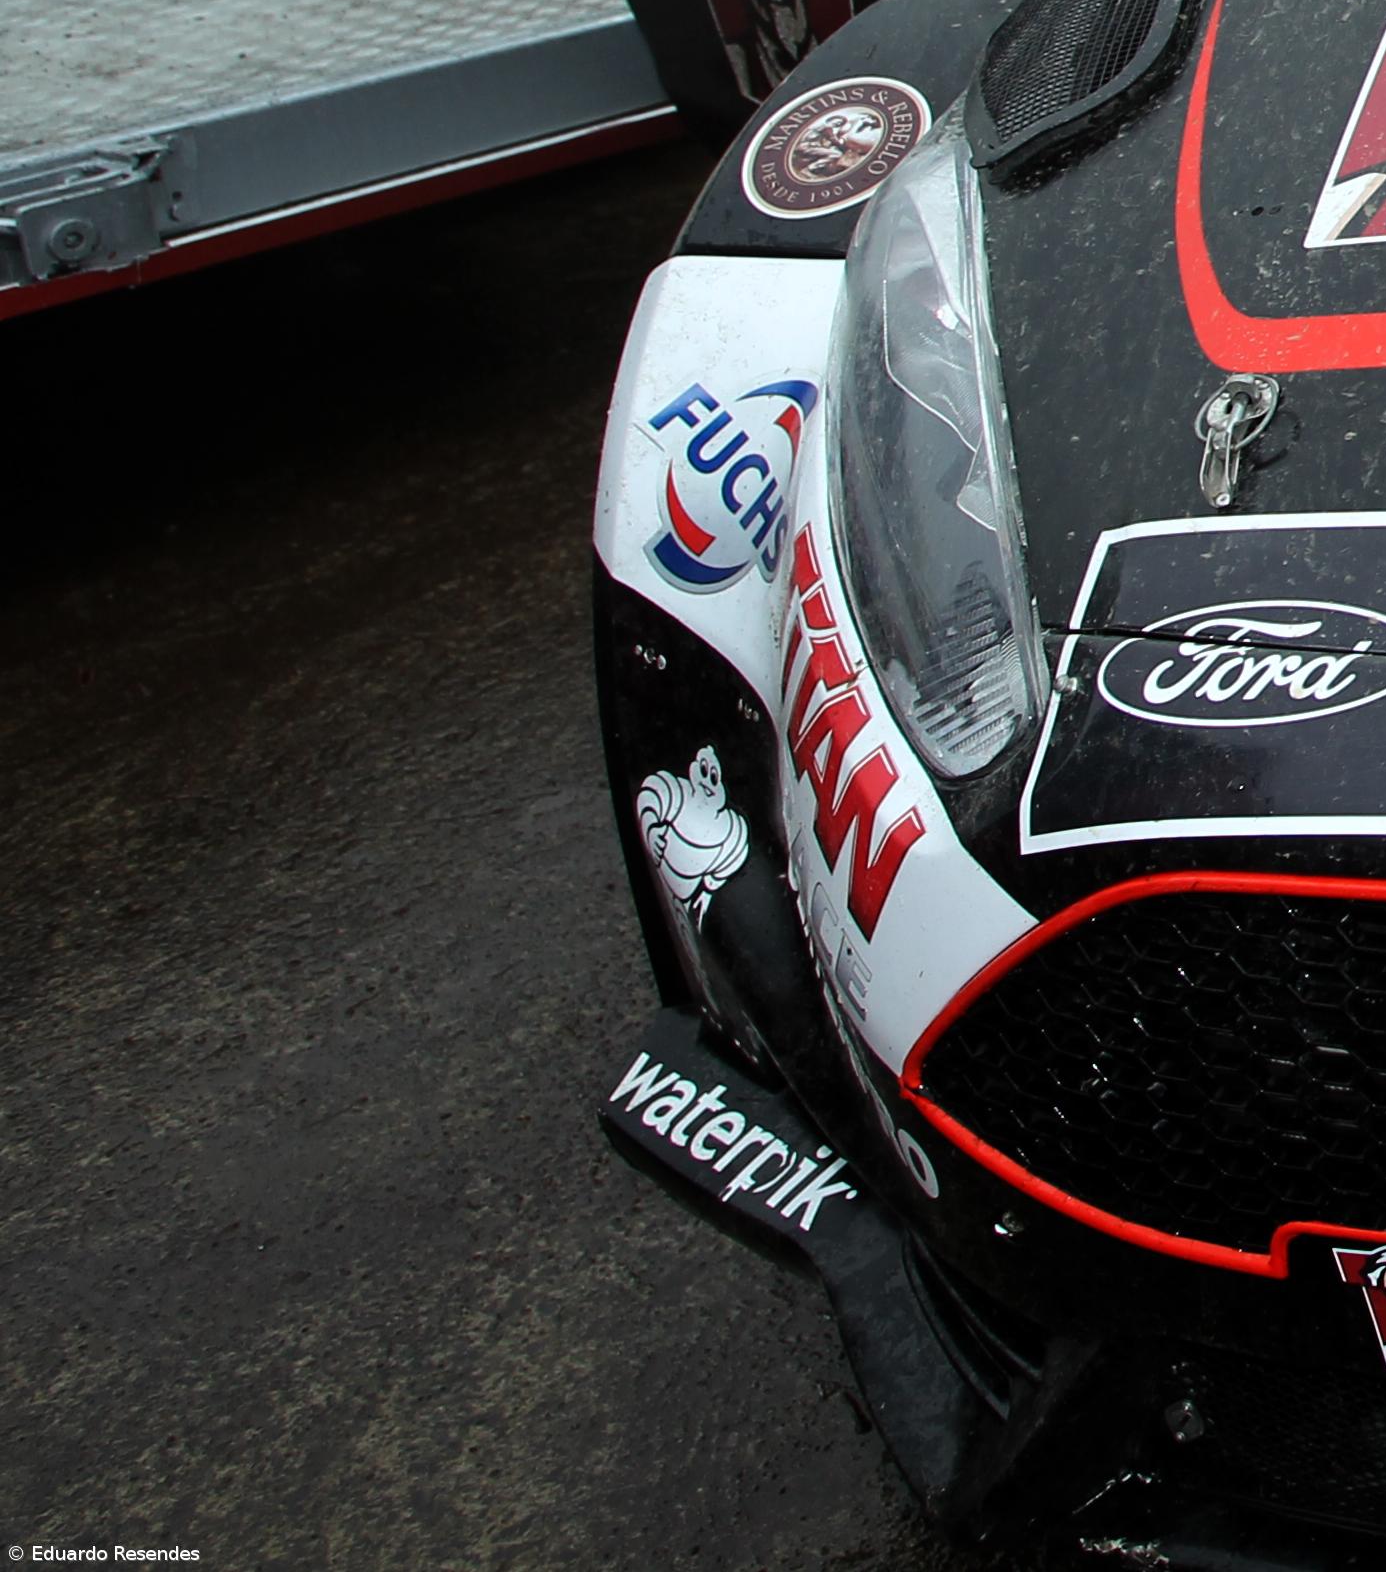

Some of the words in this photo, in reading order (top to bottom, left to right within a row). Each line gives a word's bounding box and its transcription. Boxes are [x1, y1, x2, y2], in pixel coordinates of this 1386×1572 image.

[764, 87, 865, 152] MARTINS
[870, 90, 889, 106] &
[867, 100, 913, 176] REBELLO
[760, 161, 800, 204] DESDE
[809, 180, 855, 203] 1901
[649, 382, 789, 569] FUCHS
[1144, 604, 1370, 703] Ford
[609, 1052, 848, 1231] waterpik
